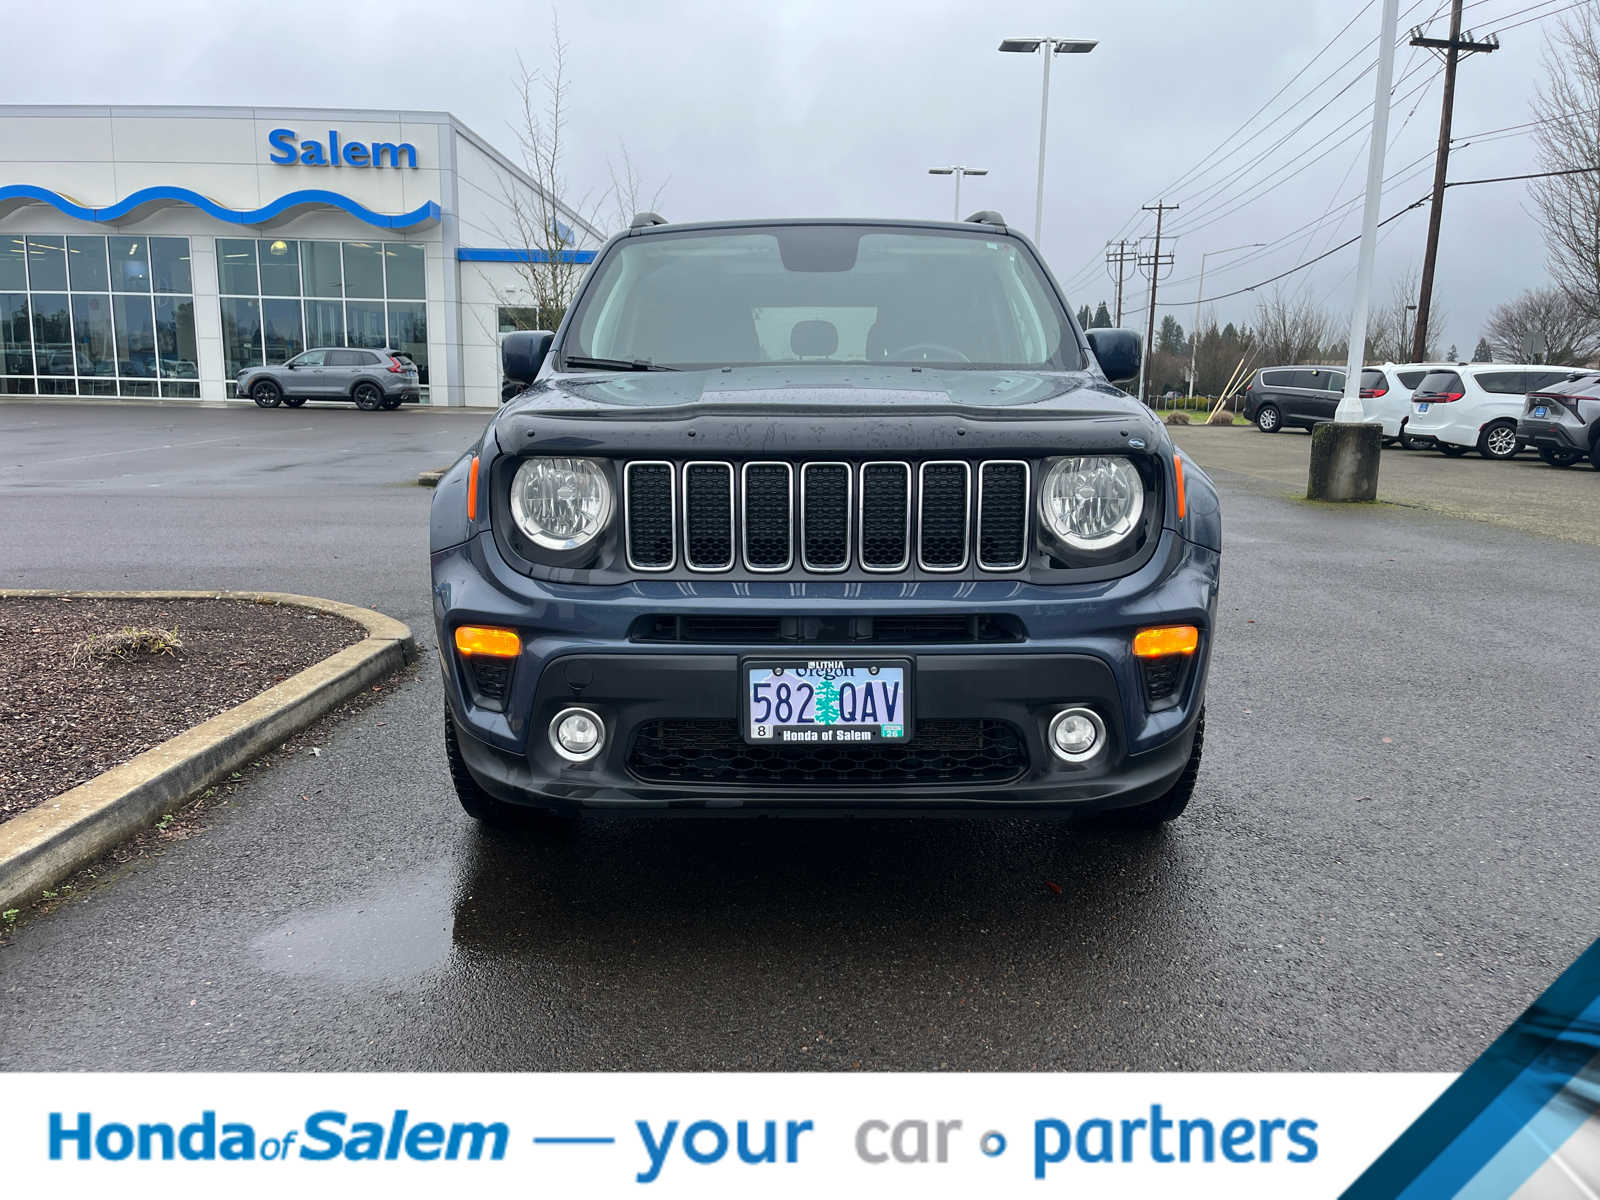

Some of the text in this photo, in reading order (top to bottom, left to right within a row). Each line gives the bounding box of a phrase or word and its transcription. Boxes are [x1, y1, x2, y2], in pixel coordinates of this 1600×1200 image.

[269, 128, 418, 169] Salem
[815, 660, 845, 669] LITHIA
[753, 681, 900, 724] 582 QAV
[757, 725, 767, 737] 8
[783, 730, 872, 741] Honda of Salem
